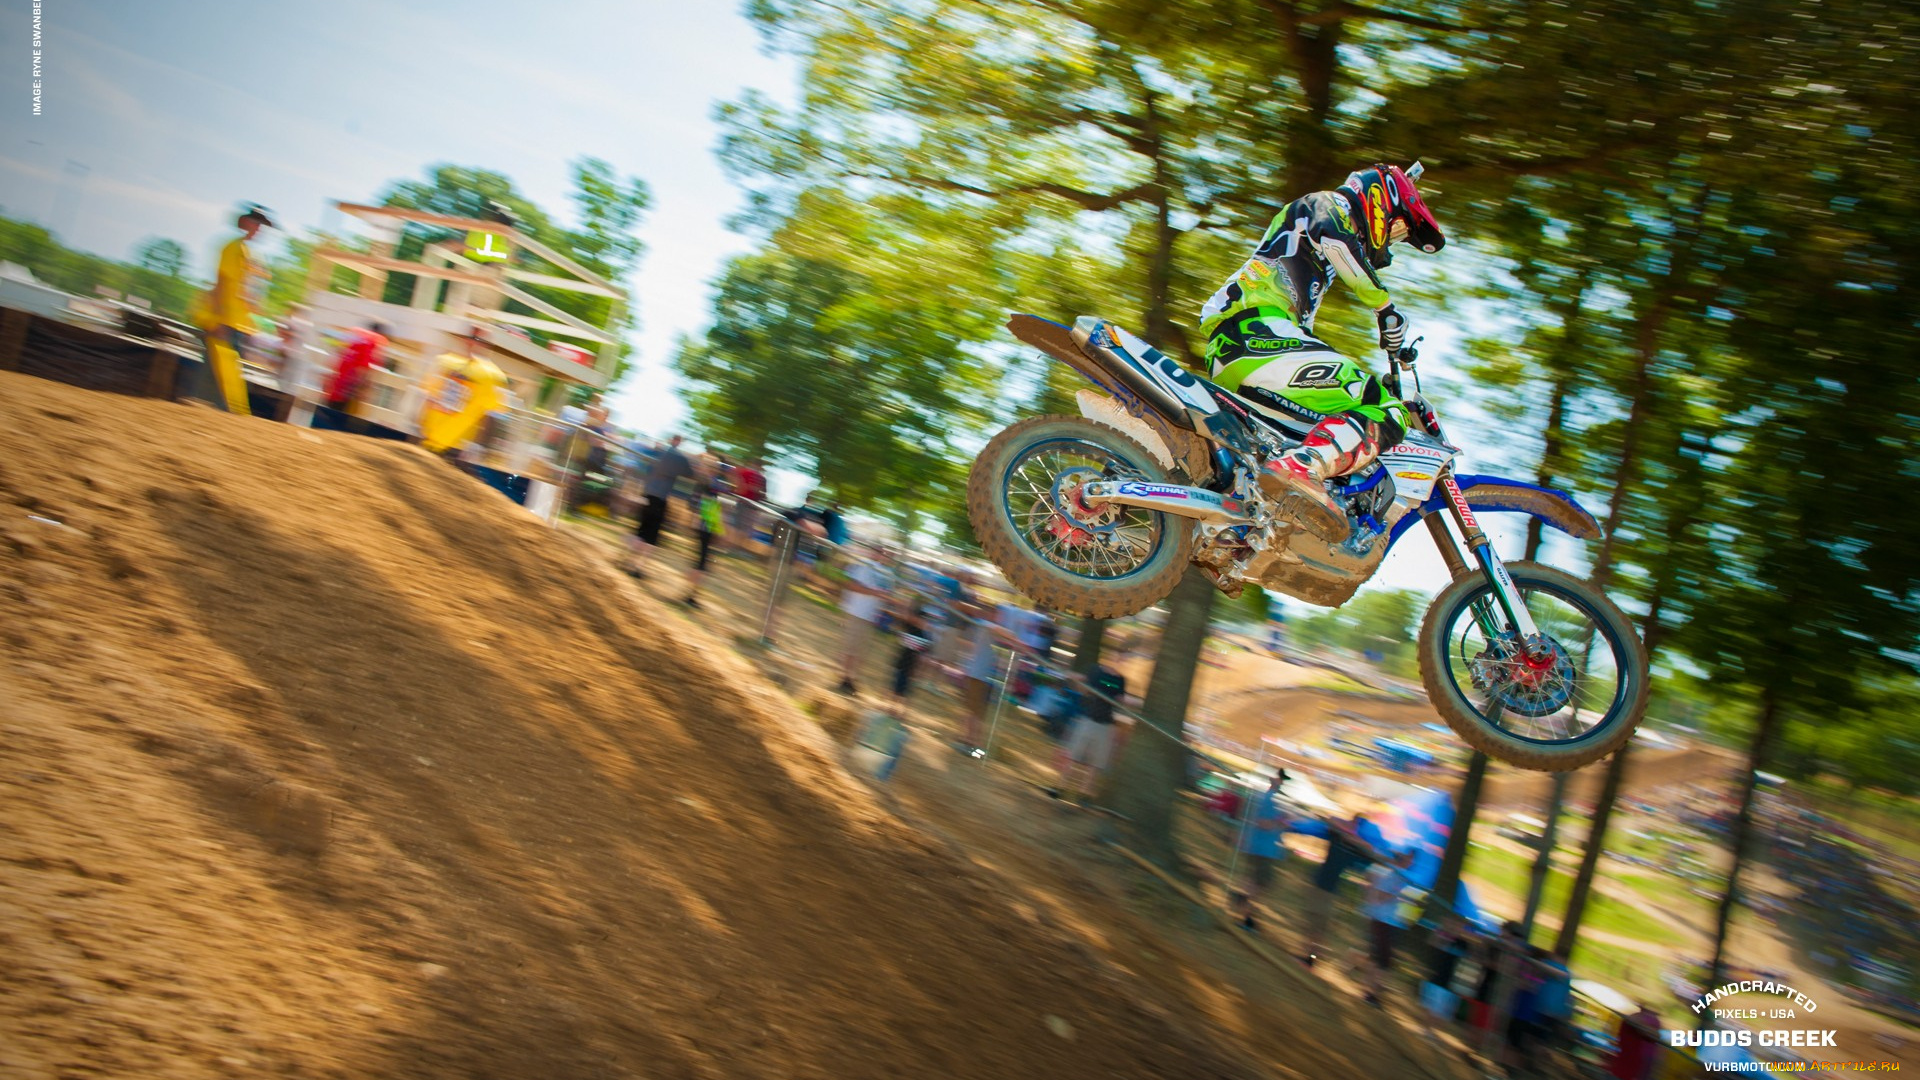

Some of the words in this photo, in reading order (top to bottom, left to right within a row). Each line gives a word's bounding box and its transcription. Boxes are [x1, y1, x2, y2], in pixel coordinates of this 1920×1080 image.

[1370, 186, 1386, 246] FMF
[1271, 392, 1326, 421] YAMAHA
[1392, 445, 1442, 457] TOYOTA
[1445, 479, 1478, 528] SHOWA
